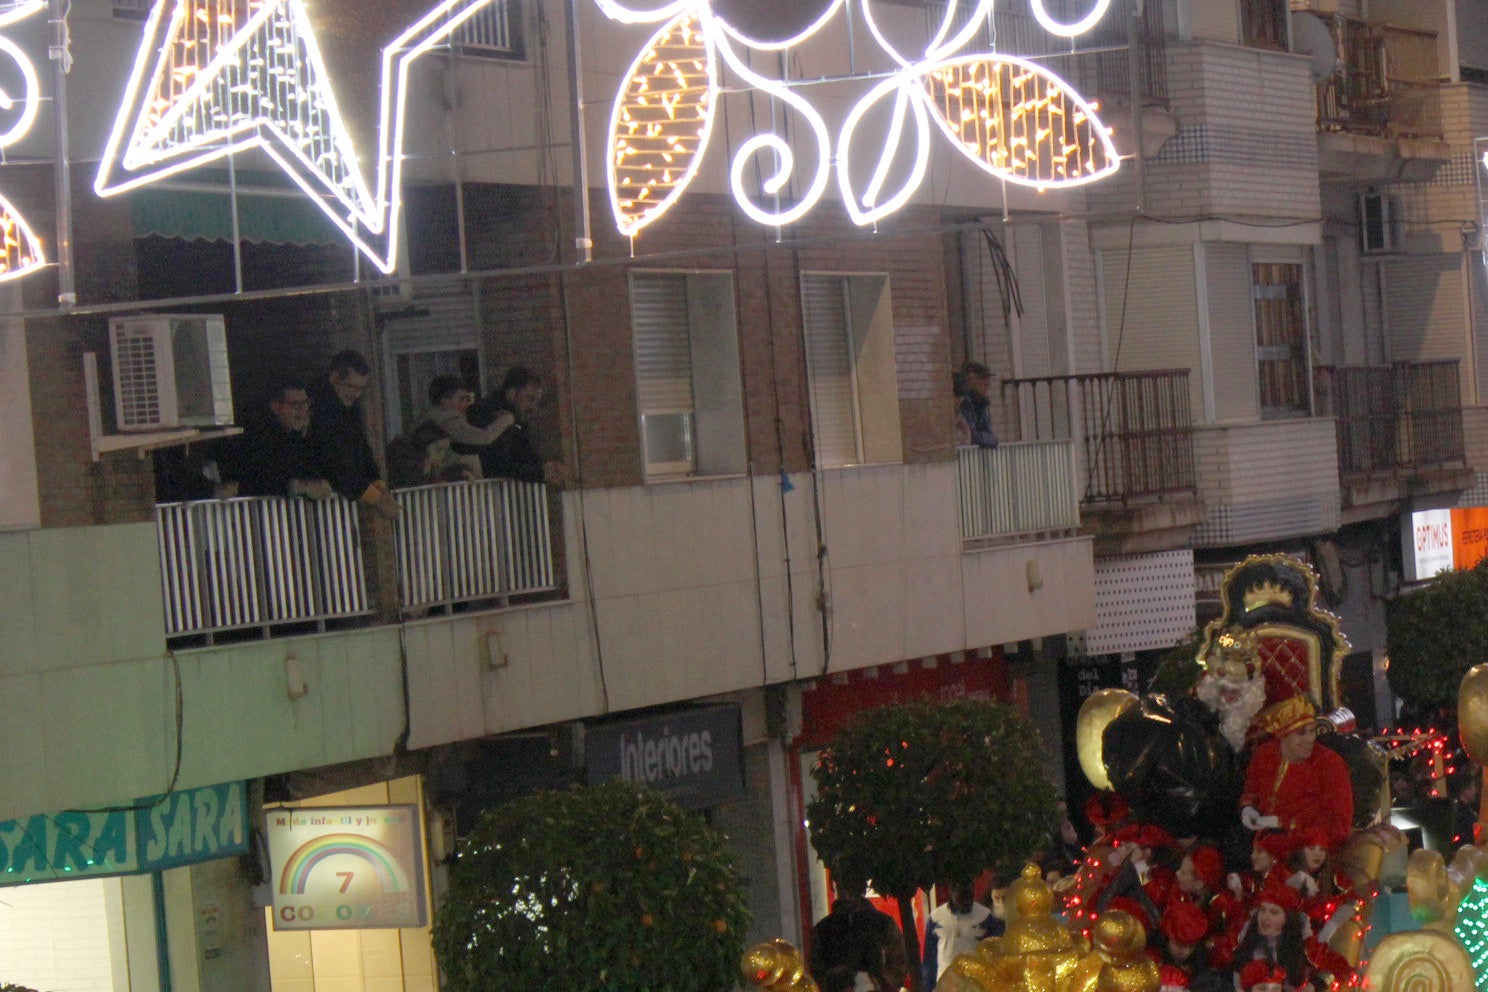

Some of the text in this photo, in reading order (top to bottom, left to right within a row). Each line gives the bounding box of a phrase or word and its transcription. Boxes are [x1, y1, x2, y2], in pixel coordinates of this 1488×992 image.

[1416, 522, 1449, 552] OPTIMUS
[620, 726, 713, 782] Interiores
[146, 782, 243, 862] SARA
[276, 817, 307, 826] Mda
[310, 816, 352, 826] infatil
[336, 872, 355, 894] 7
